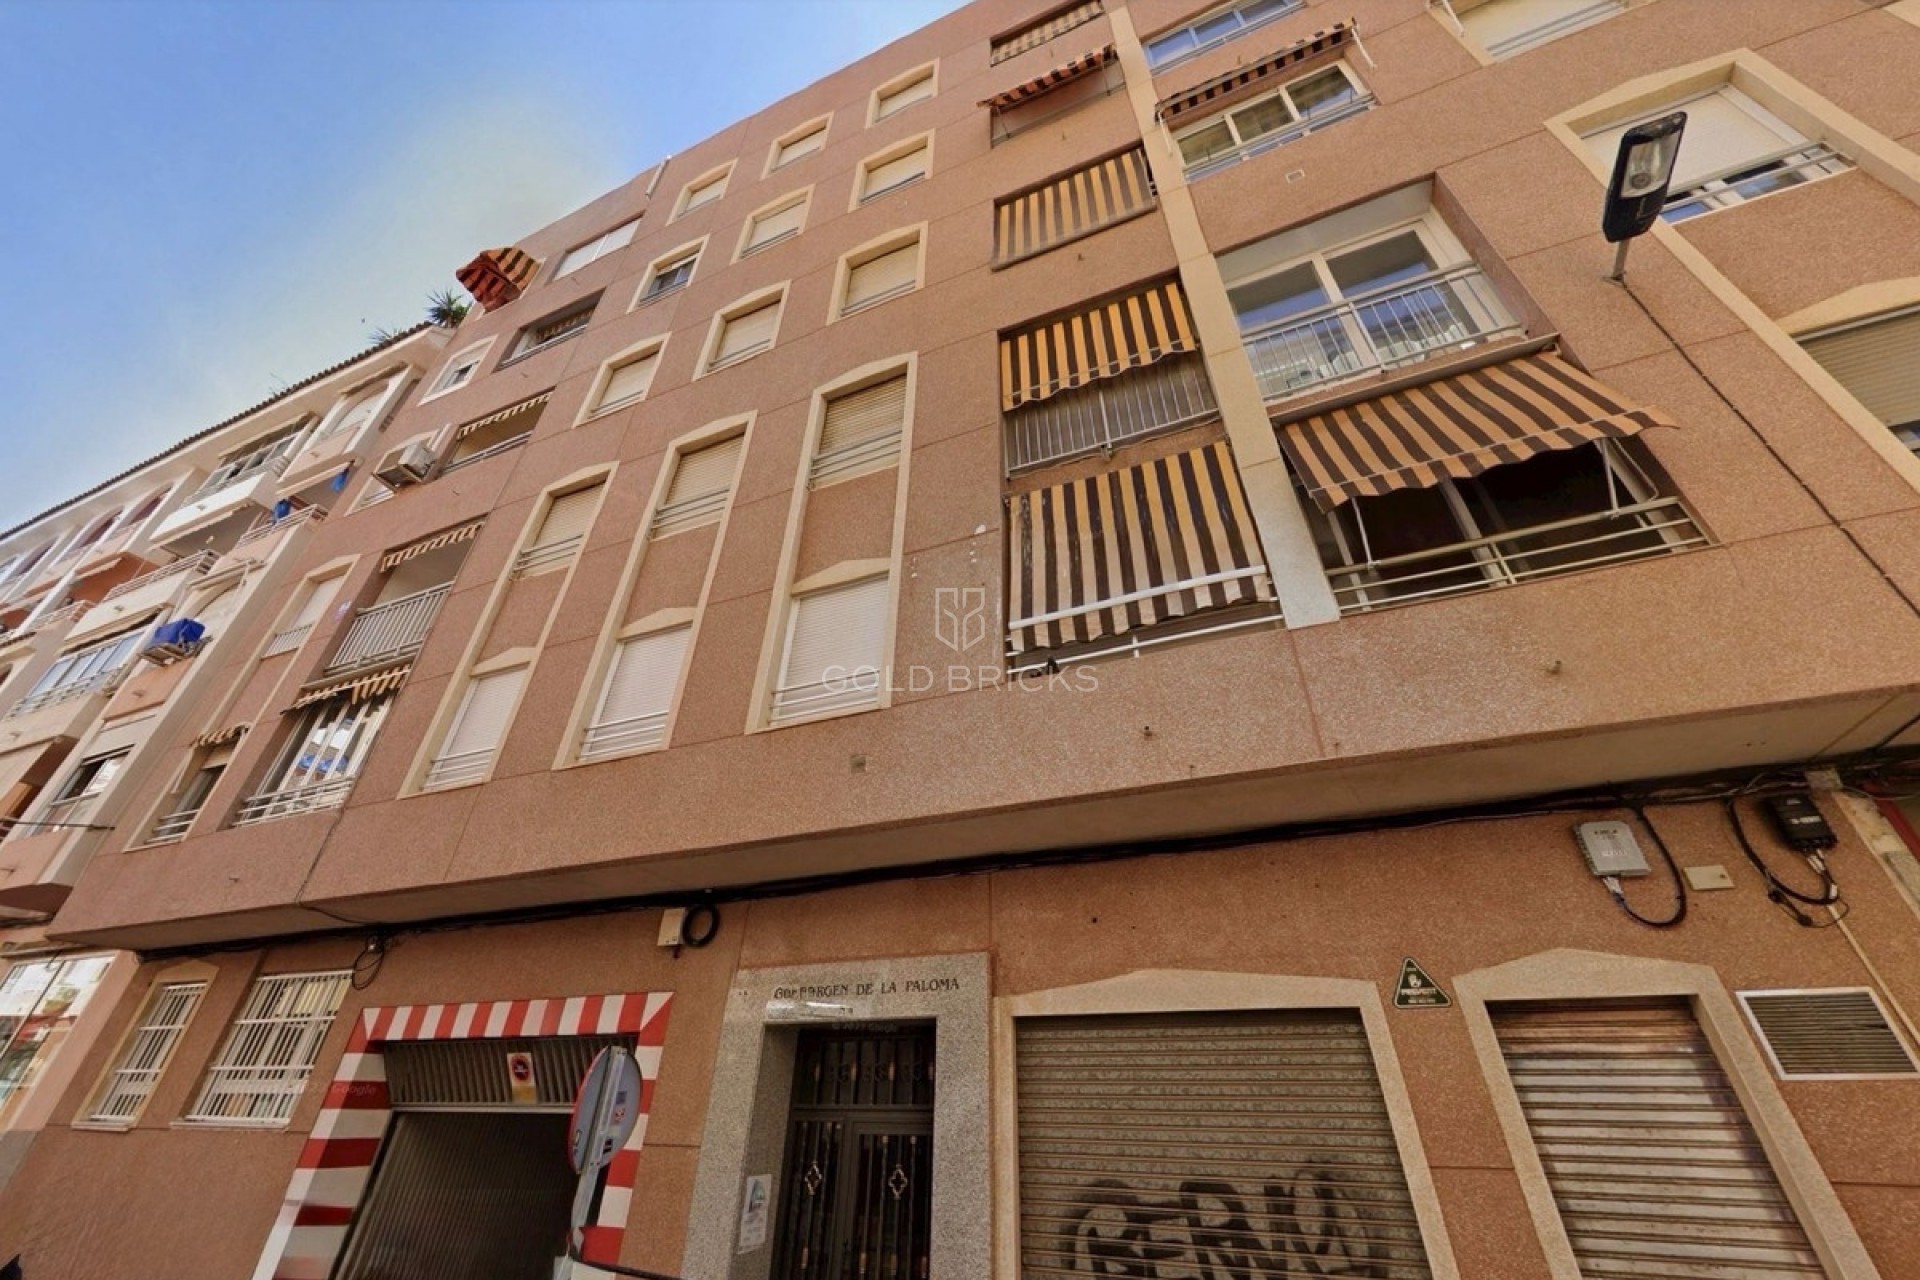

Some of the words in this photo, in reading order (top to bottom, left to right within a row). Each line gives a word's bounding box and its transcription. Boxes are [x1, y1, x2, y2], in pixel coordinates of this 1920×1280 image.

[856, 983, 874, 996] DE
[881, 981, 897, 994] LA
[905, 977, 960, 993] PALOMA
